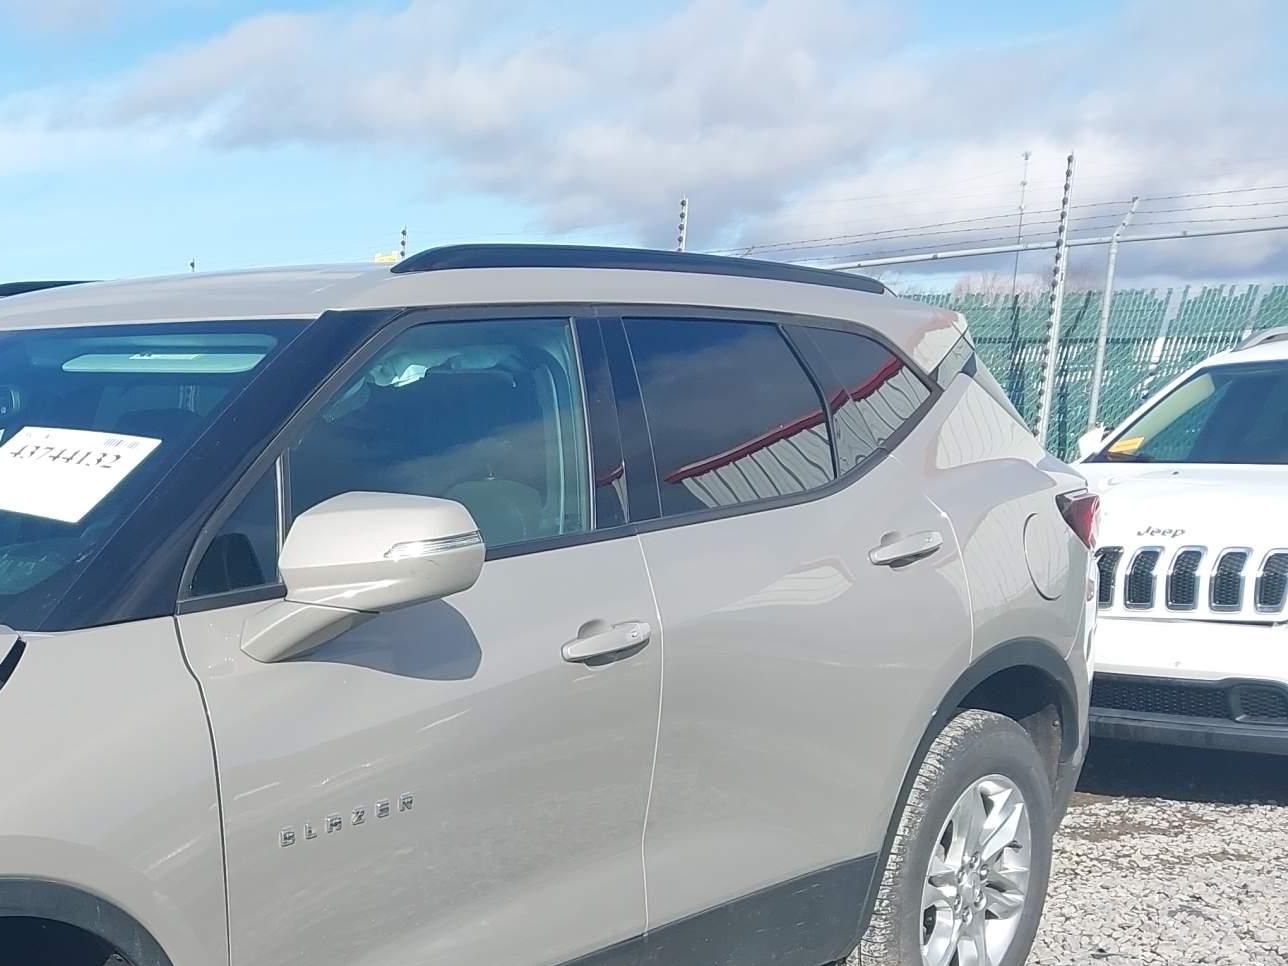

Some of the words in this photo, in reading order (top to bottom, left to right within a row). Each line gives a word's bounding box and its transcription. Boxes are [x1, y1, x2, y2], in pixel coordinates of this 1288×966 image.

[10, 444, 122, 469] 43744132
[1136, 525, 1186, 539] Jeep
[278, 792, 414, 847] BLAZER
